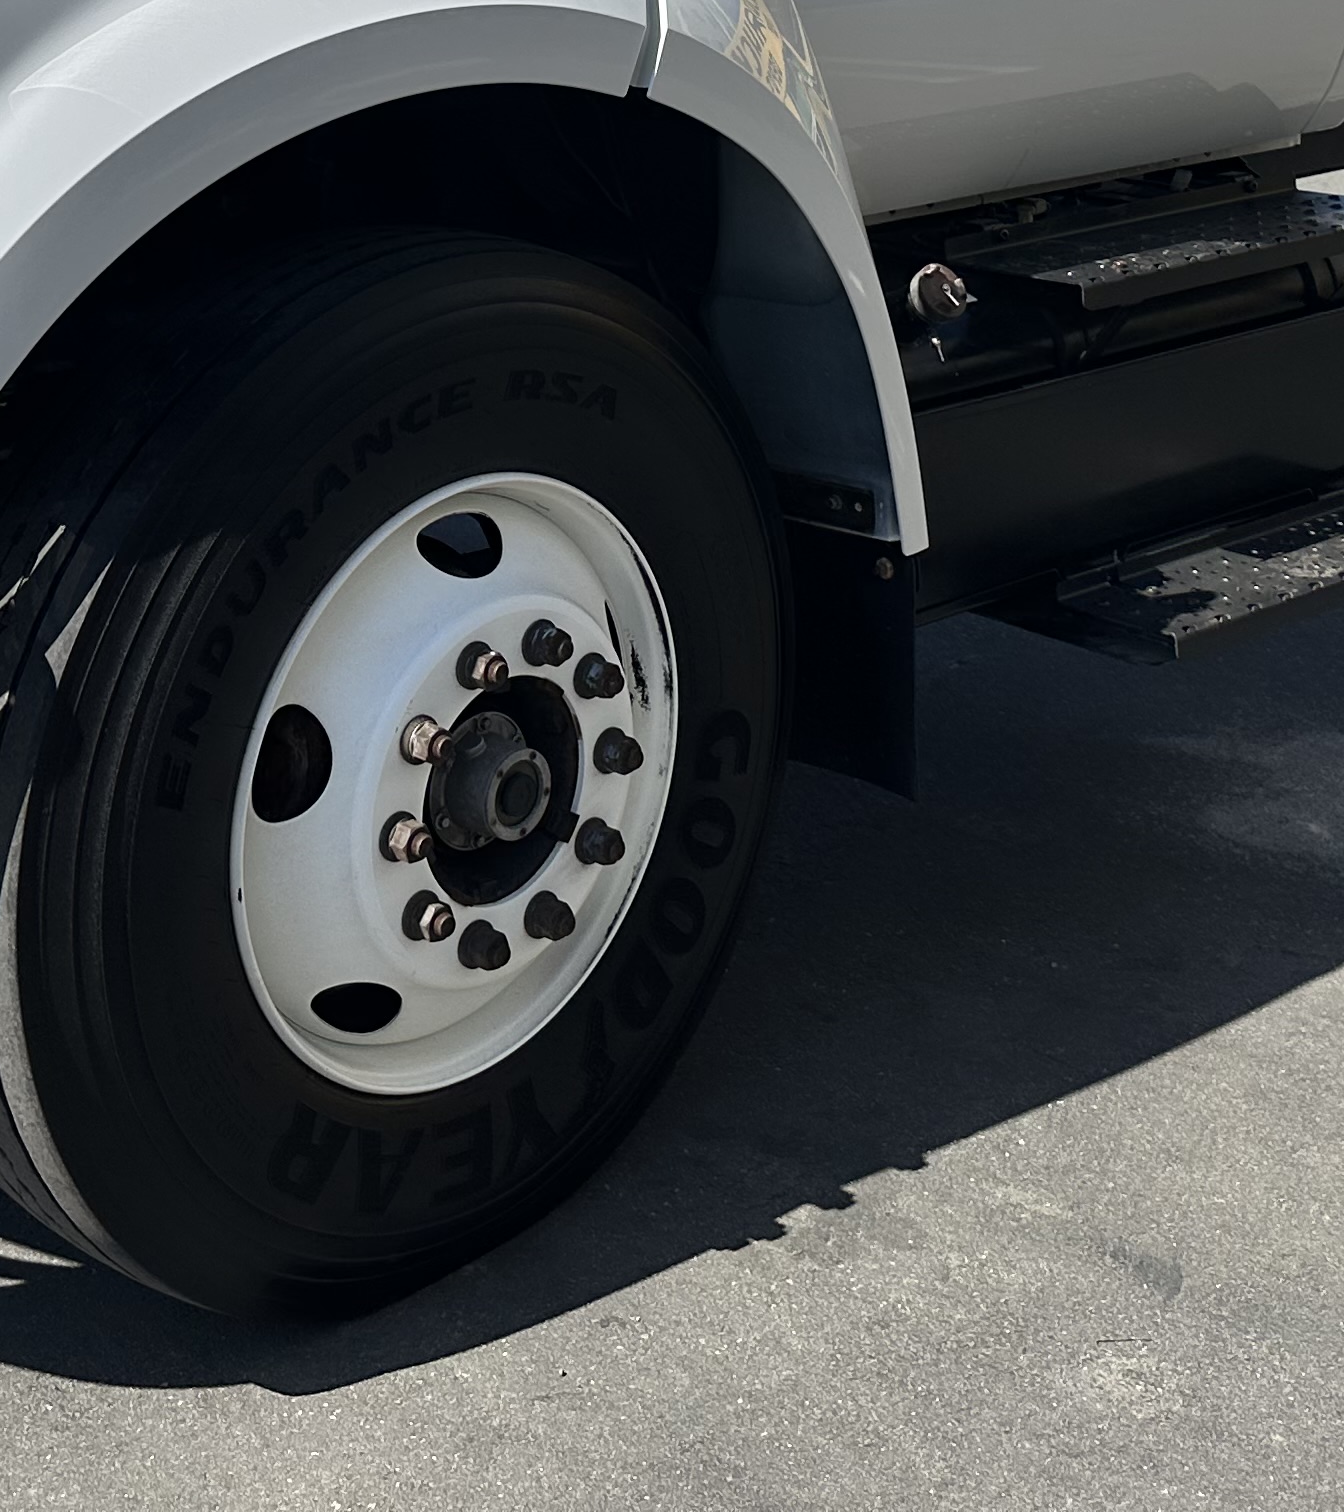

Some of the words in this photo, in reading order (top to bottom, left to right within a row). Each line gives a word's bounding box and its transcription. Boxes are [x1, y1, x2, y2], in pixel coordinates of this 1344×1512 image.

[157, 377, 476, 811] ENDURANCE
[503, 368, 618, 421] RSA
[267, 707, 752, 1216] GOODYEAR
